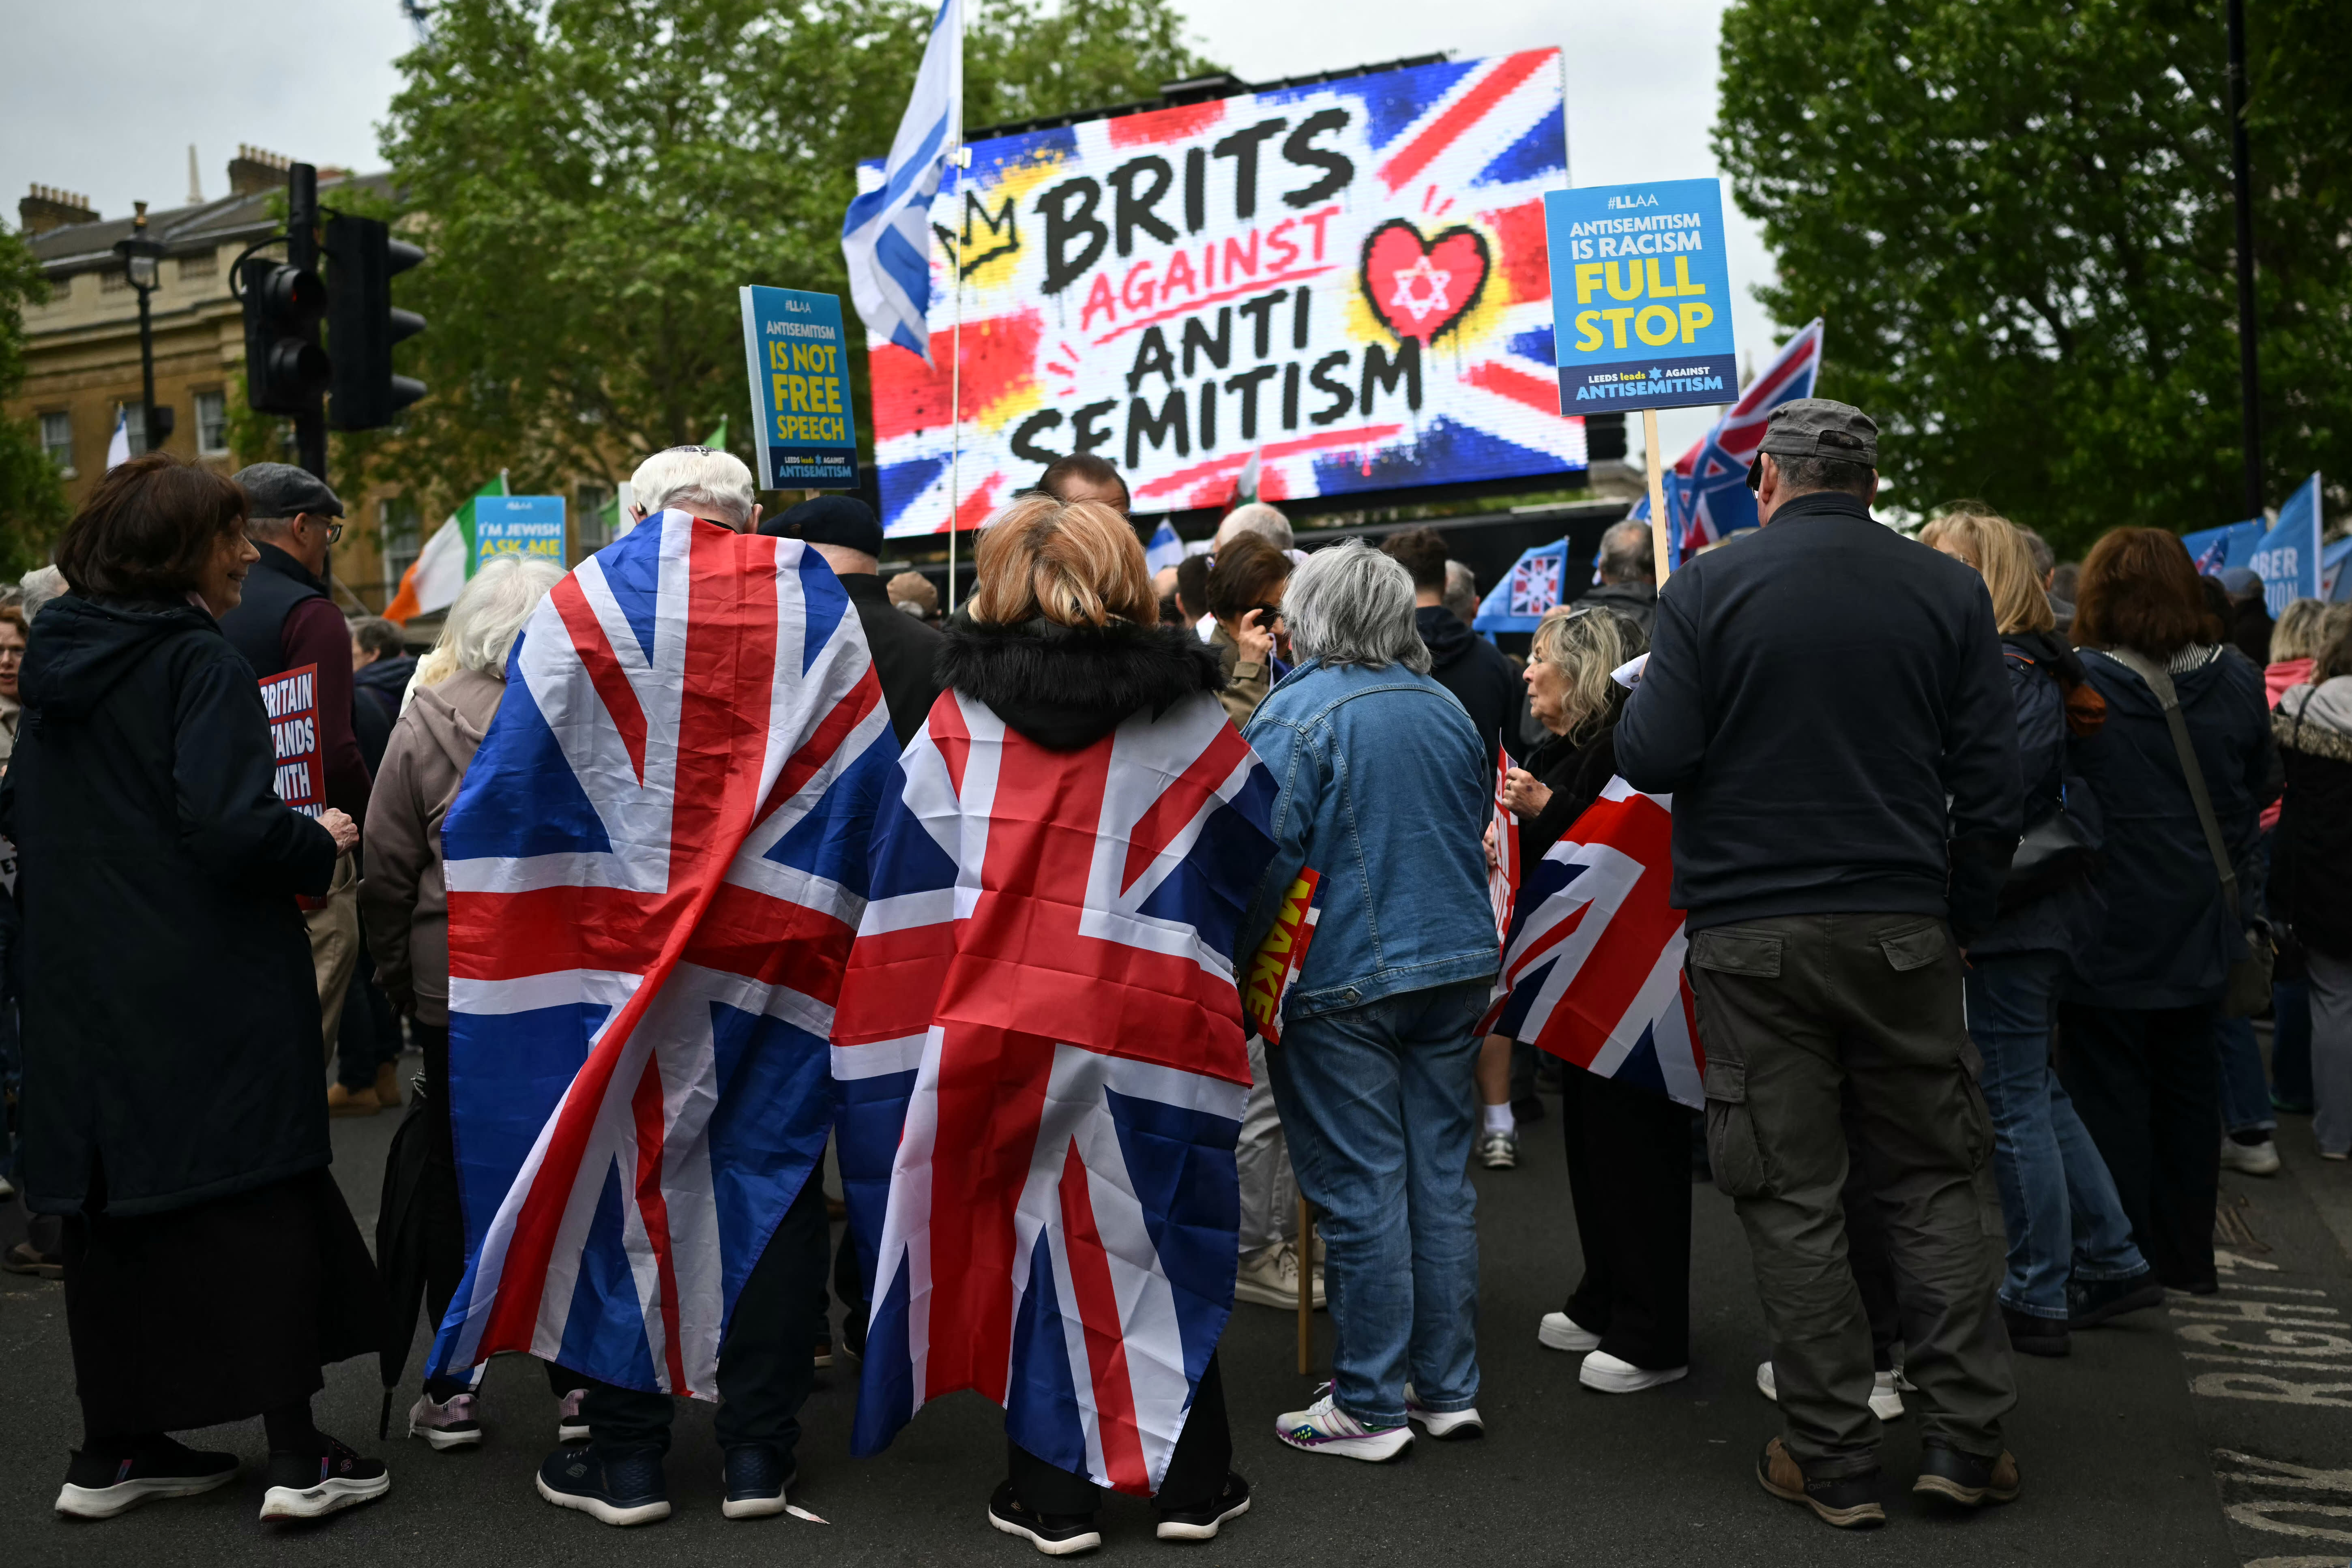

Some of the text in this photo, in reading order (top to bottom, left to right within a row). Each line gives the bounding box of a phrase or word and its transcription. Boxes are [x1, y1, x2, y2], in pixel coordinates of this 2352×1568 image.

[1032, 108, 1354, 295] BRITS
[1608, 193, 1659, 210] #LLAA
[1570, 213, 1701, 237] ANTISEMITISM
[1571, 230, 1702, 260] IS RACISM
[1081, 206, 1340, 331] AGAINST
[1575, 255, 1706, 304] FULL
[766, 320, 836, 340] ANTISEMITISM
[1126, 285, 1310, 393] ANTI
[1575, 302, 1714, 352] STOP
[769, 341, 837, 373] IS NOT
[1576, 376, 1723, 401] ANTISEMITISM
[1588, 367, 1710, 383] LEEDS leads AGAINST
[772, 373, 843, 413] FREE
[777, 415, 845, 441] SPEECH
[1010, 335, 1422, 495] SEMITISM
[779, 465, 852, 478] ANTISEMITISM
[479, 521, 561, 537] I'M JEWISH
[480, 539, 560, 556] ASK ME
[1246, 878, 1311, 1025] MAKE
